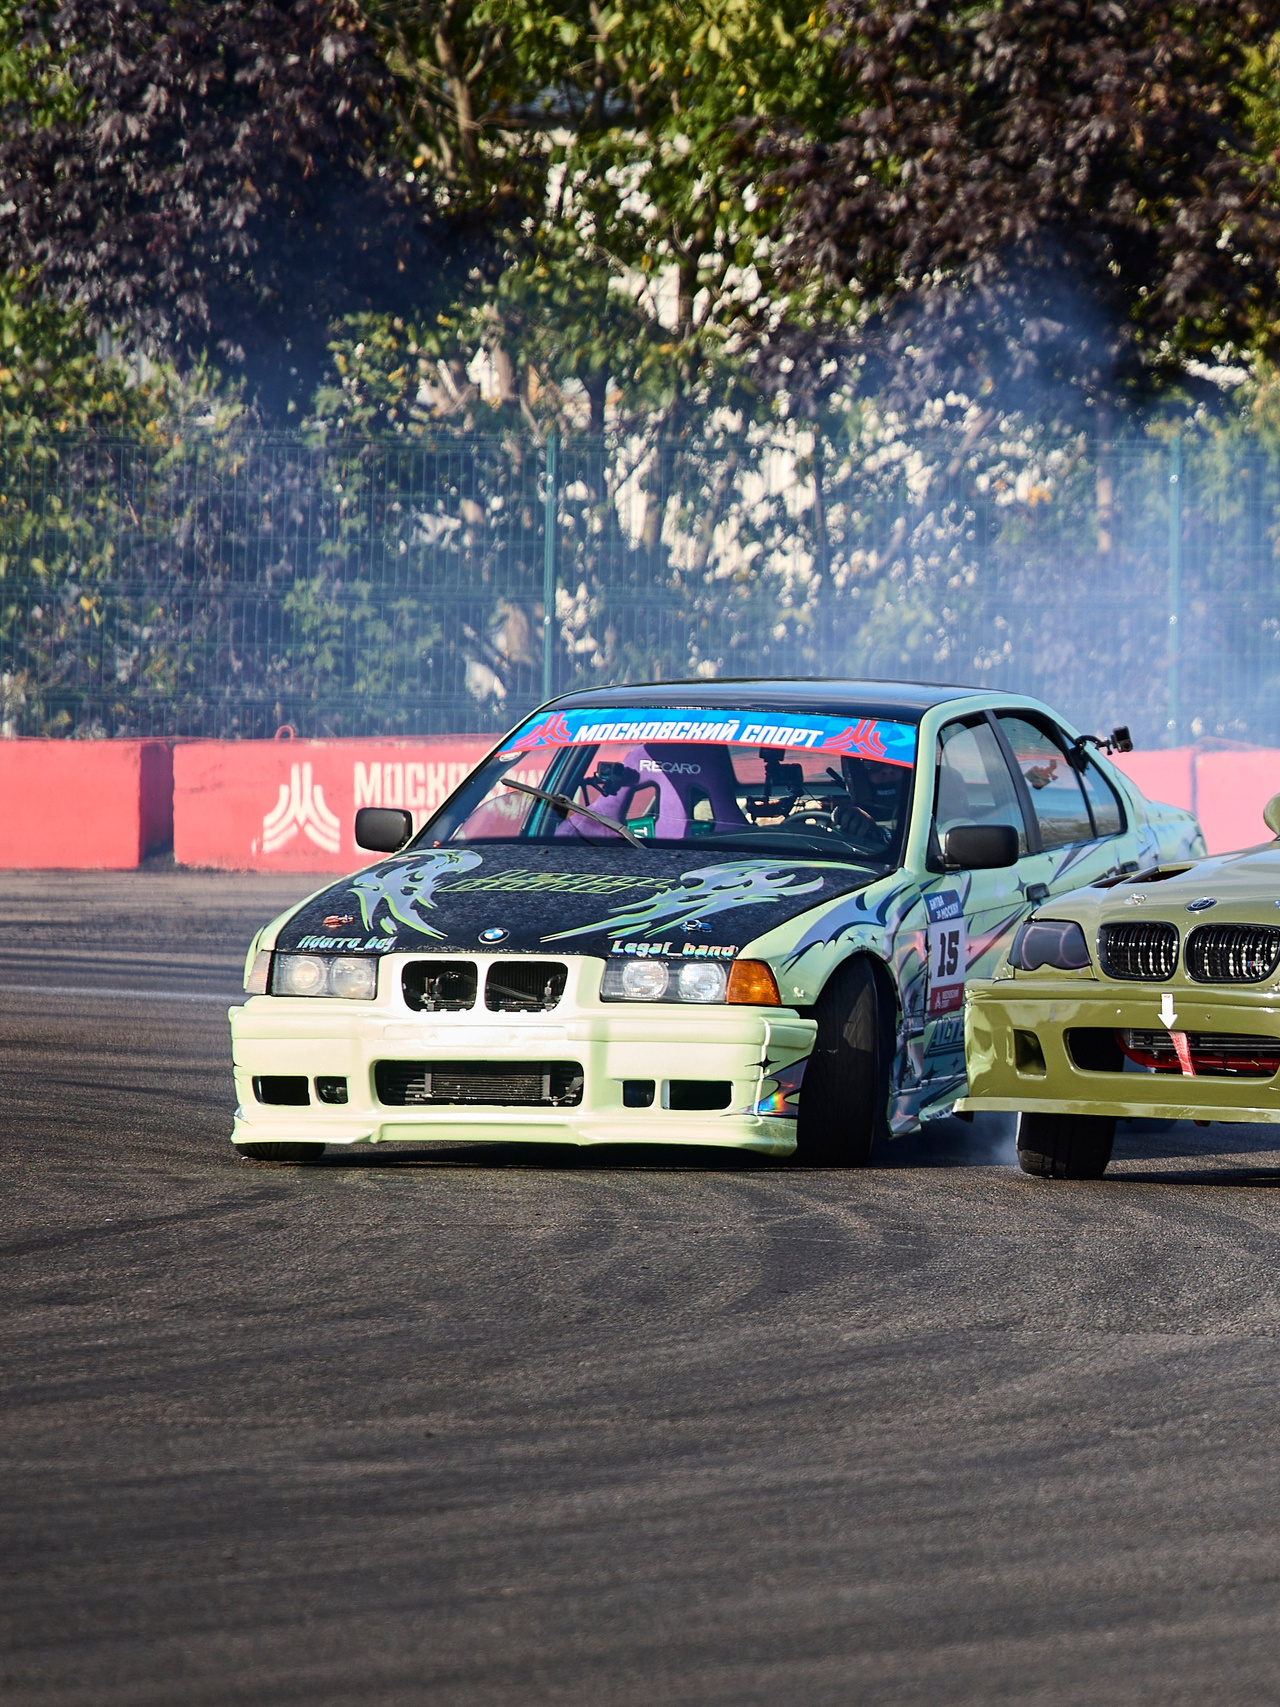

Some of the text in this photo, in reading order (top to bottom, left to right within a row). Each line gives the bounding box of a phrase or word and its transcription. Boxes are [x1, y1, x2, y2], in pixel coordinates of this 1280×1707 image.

[573, 720, 825, 748] МОСКОВСКИЙ СПОРТ
[639, 759, 702, 774] RECARO
[937, 930, 960, 977] 15
